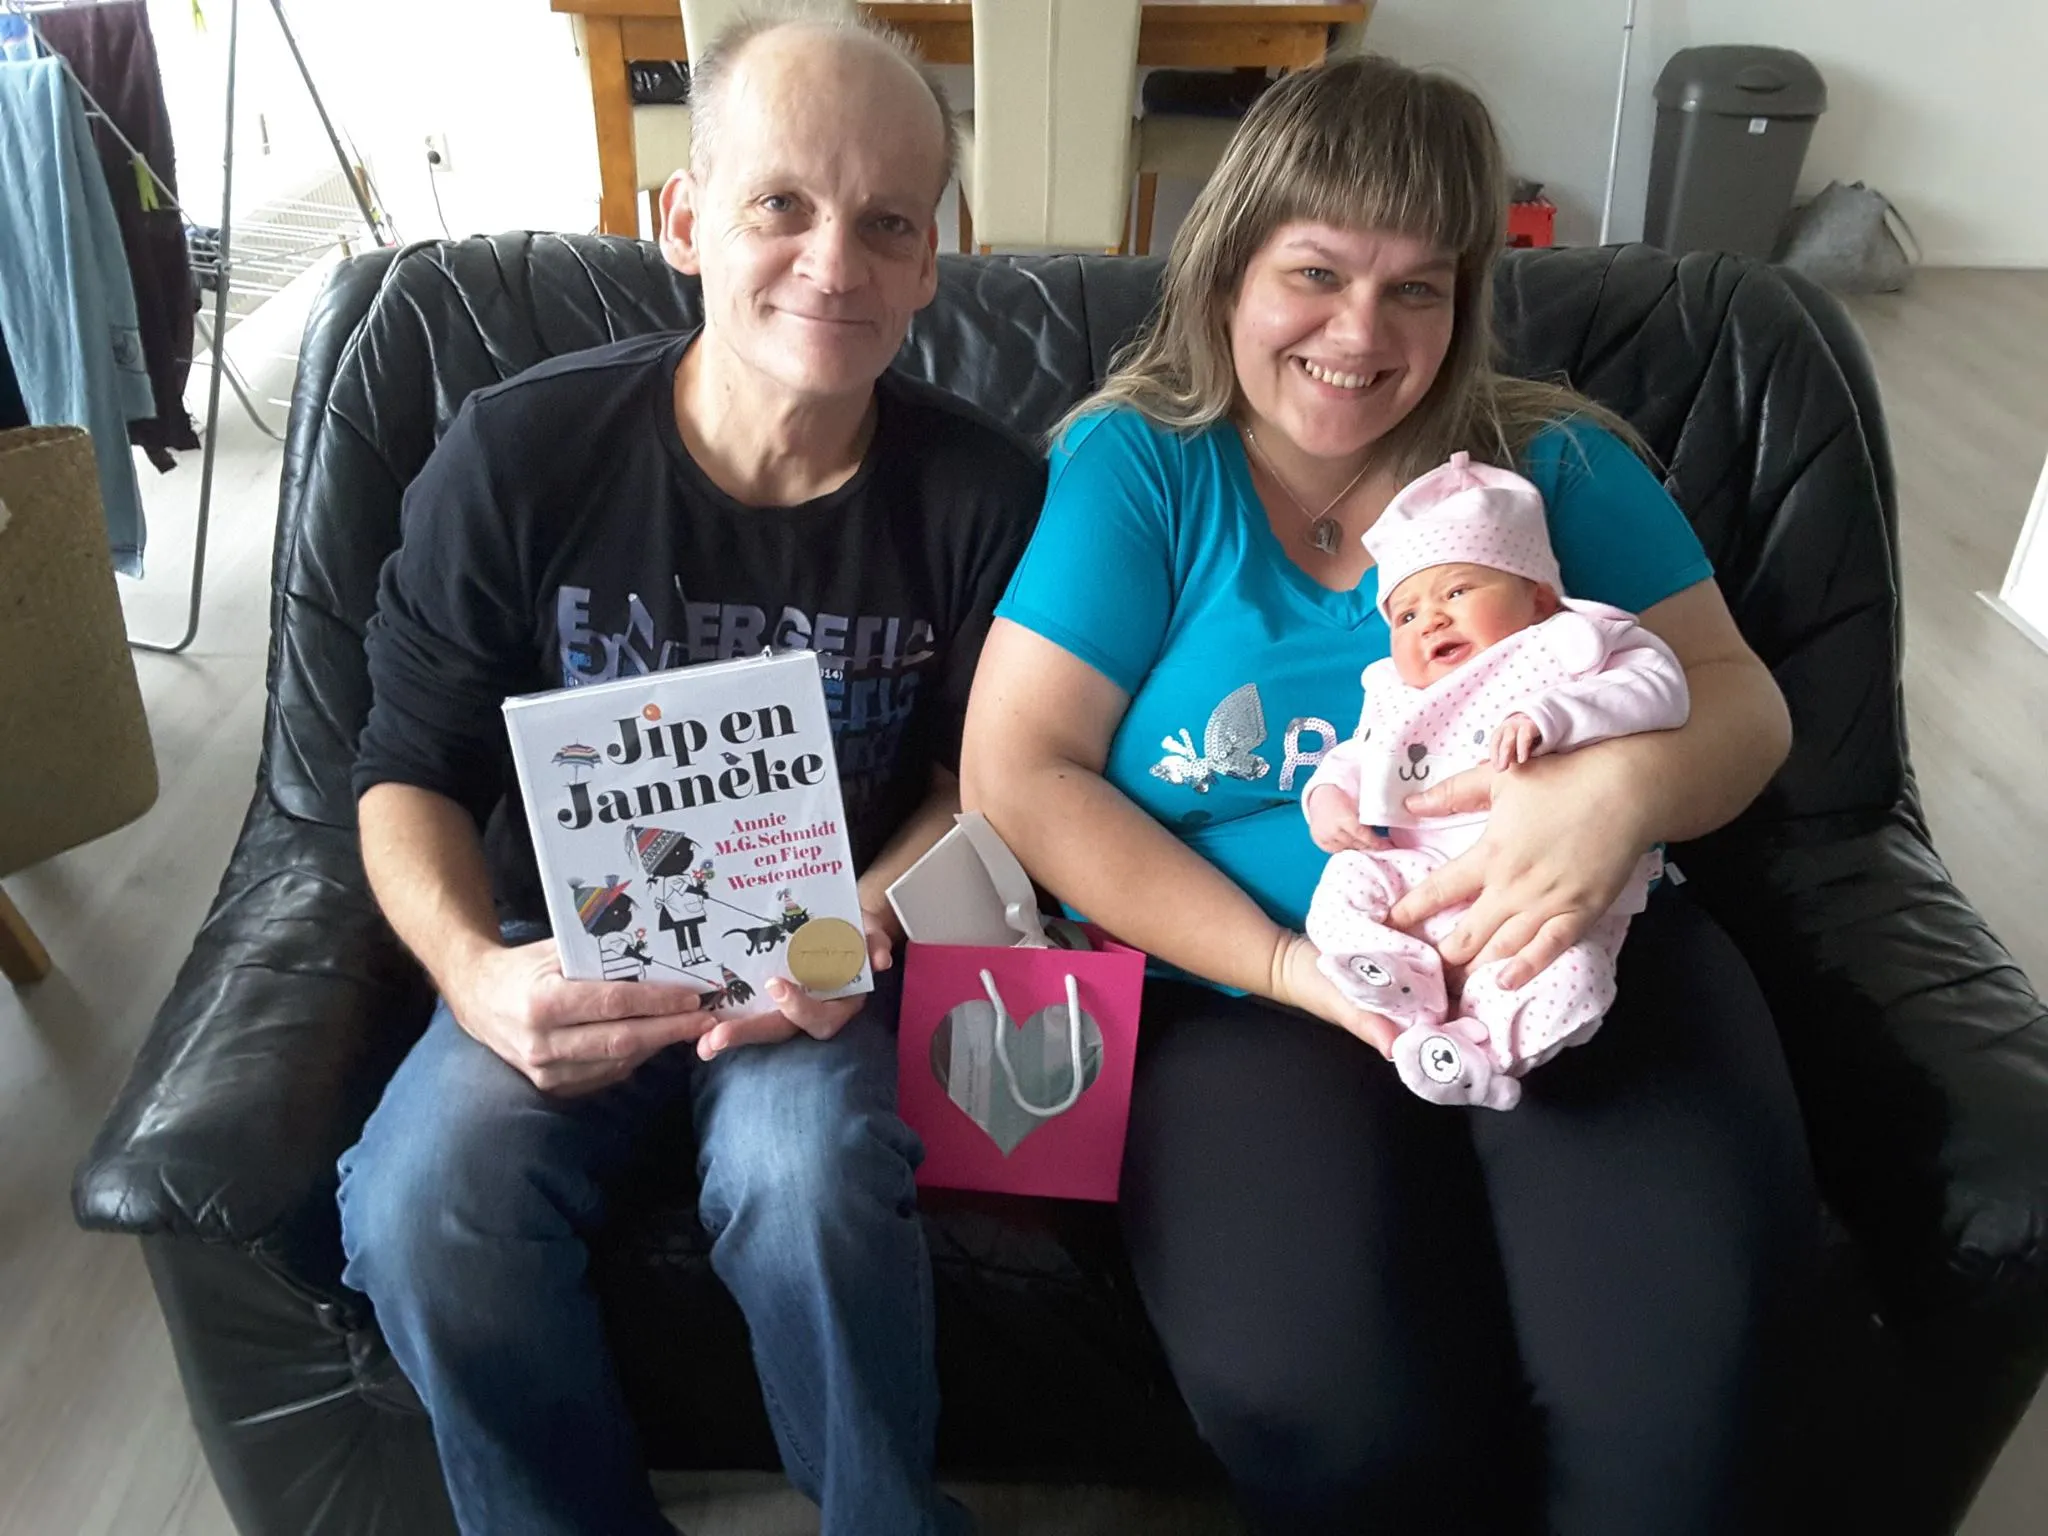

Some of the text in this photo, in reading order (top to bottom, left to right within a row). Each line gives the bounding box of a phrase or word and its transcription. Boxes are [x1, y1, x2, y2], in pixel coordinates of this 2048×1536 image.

[606, 703, 708, 769] Jip
[720, 704, 799, 744] en
[730, 812, 787, 834] Annie
[754, 844, 822, 868] en Fiep
[727, 859, 843, 890] Westendorp
